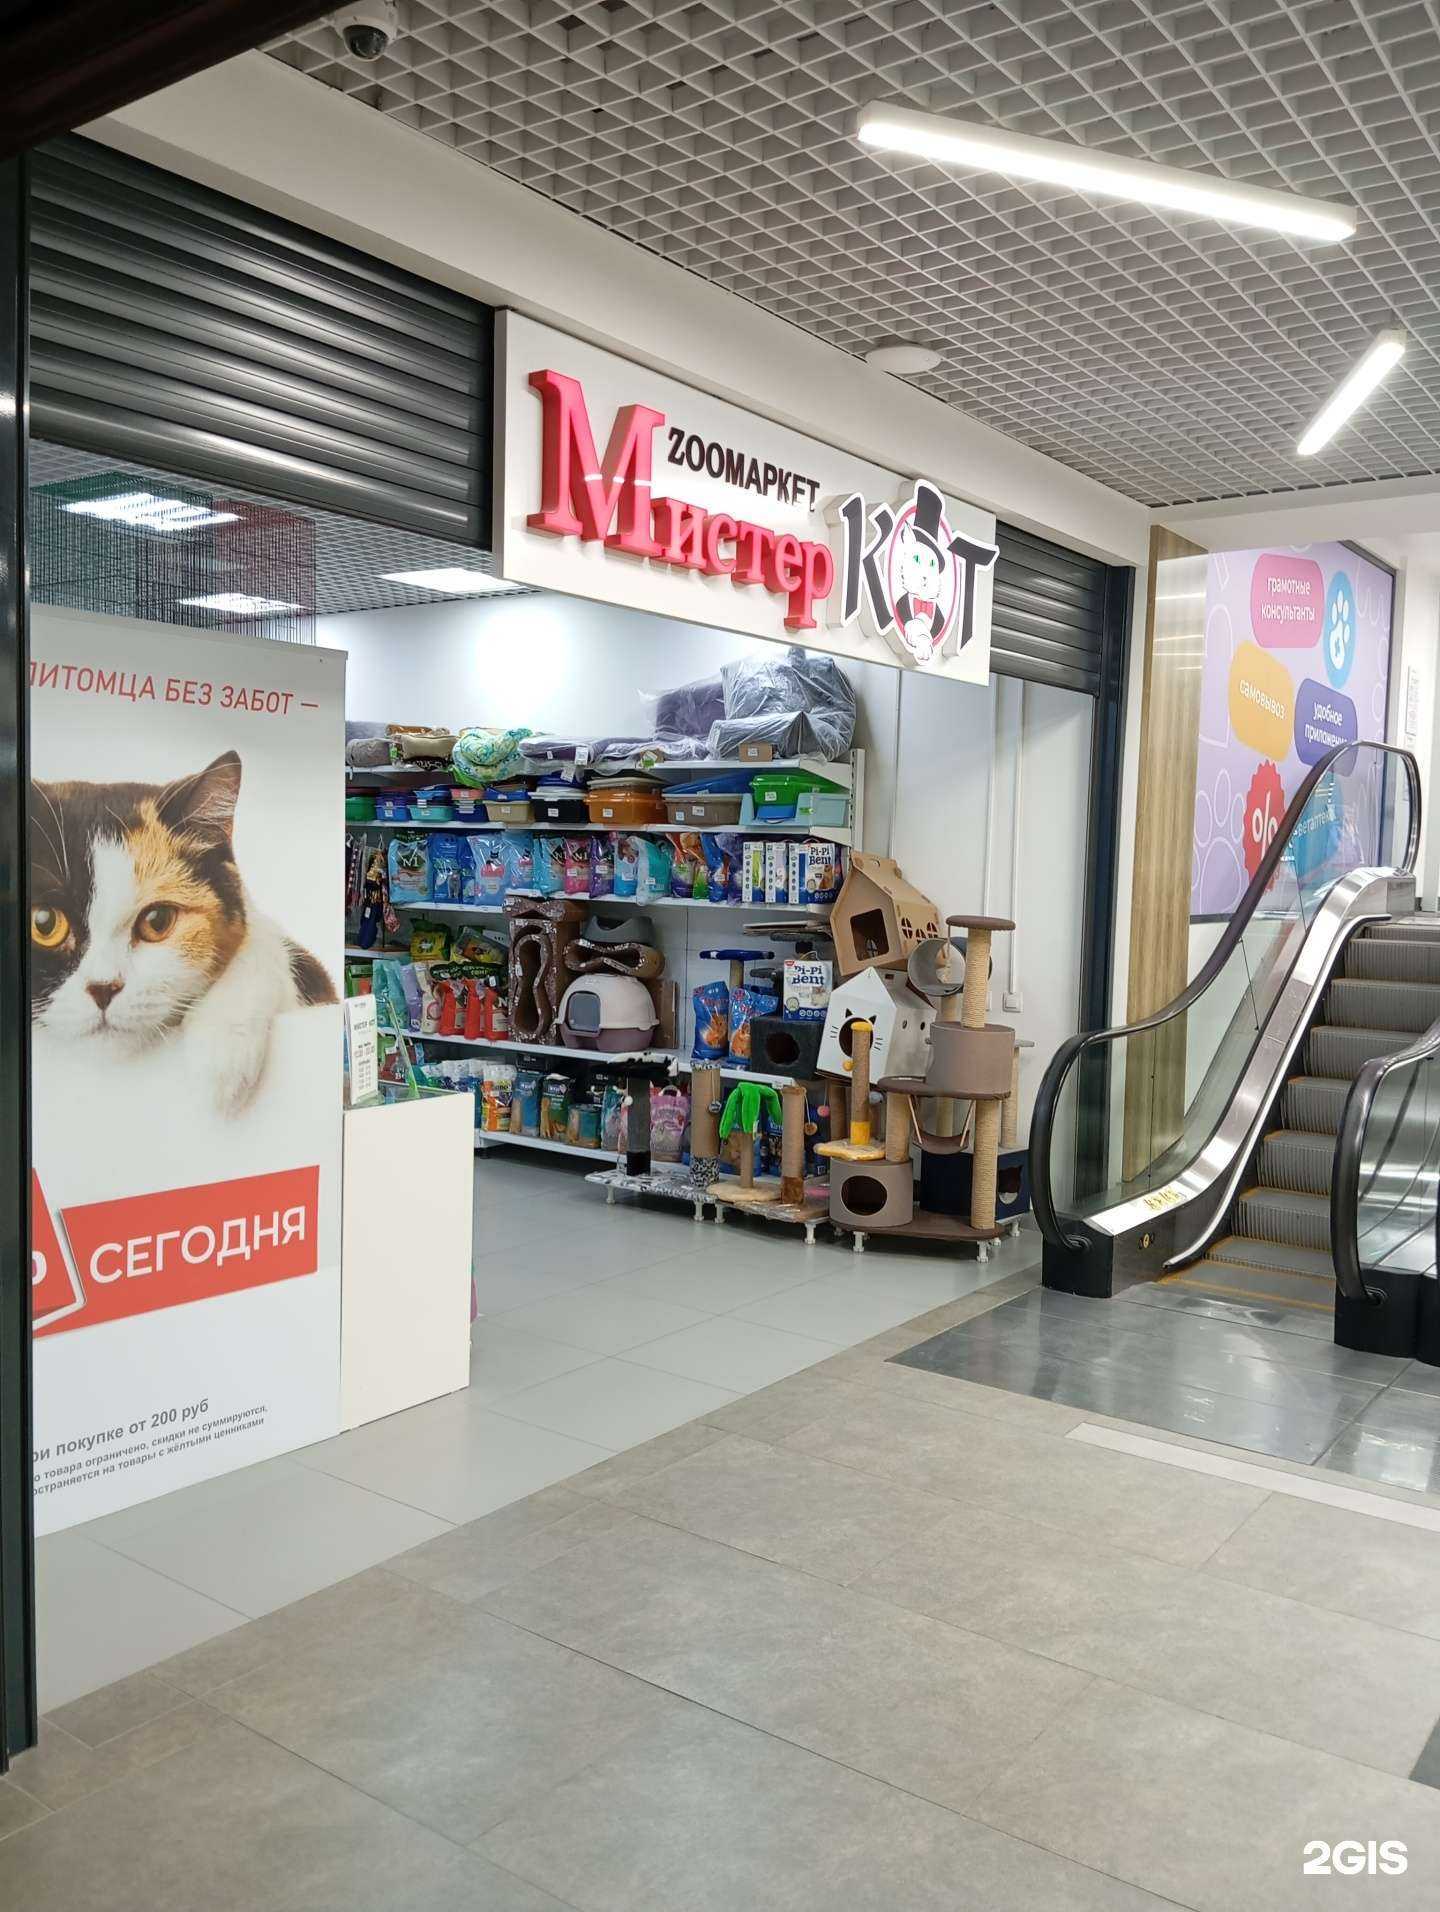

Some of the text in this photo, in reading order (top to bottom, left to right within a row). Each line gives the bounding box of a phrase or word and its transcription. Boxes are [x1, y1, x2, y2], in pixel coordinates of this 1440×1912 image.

[527, 368, 834, 630] Мистер
[1267, 576, 1311, 597] грамотные
[1261, 603, 1315, 625] консультанты
[165, 678, 213, 705] БЕЗ
[220, 685, 294, 715] ЗАБОТ
[1239, 679, 1286, 720] самовывоз
[1313, 702, 1343, 726] удобное
[809, 855, 832, 866] Bent
[89, 1205, 306, 1284] СЕГОДНЯ
[56, 1427, 124, 1456] покупке
[128, 1420, 147, 1434] от
[151, 1408, 177, 1429] 200
[181, 1398, 209, 1422] руб
[102, 1465, 115, 1476] на
[118, 1452, 156, 1470] товары
[158, 1448, 165, 1457] с
[214, 1418, 264, 1440] ценниками
[44, 1461, 82, 1480] товара
[151, 1430, 186, 1447] скидки
[188, 1425, 200, 1436] не
